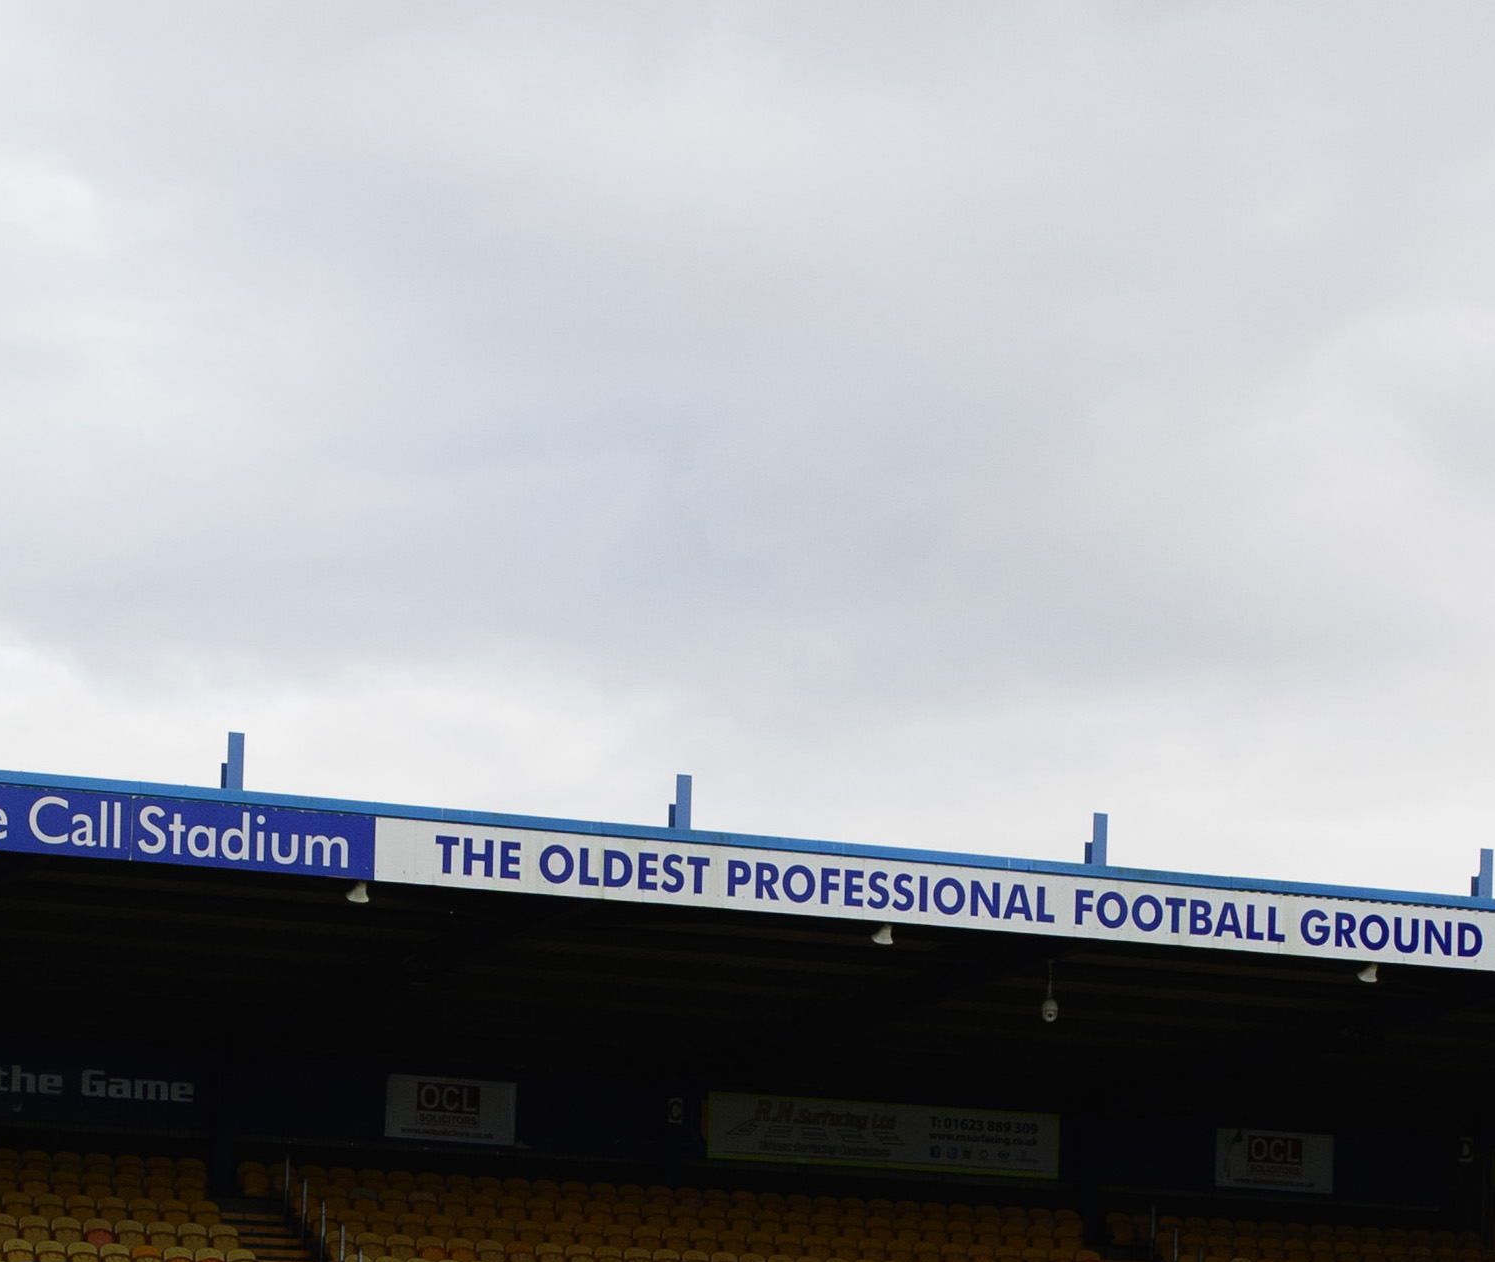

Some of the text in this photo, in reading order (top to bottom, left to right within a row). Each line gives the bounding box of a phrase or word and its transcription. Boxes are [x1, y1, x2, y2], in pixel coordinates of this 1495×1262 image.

[29, 796, 121, 849] Call
[138, 805, 349, 868] Stadium
[435, 835, 520, 880] THE
[539, 844, 709, 893] OLDEST
[728, 860, 1055, 923] PROFESSIONAL
[1075, 889, 1285, 943] FOOTBALL
[1300, 909, 1483, 957] GROUND
[81, 1069, 194, 1102] Game
[420, 1084, 478, 1113] OCL
[418, 1114, 478, 1126] SOLICITORS
[930, 1116, 1038, 1135] T: 01623 889 309
[1250, 1137, 1300, 1163] OCL
[1249, 1164, 1301, 1176] SOLICITORS
